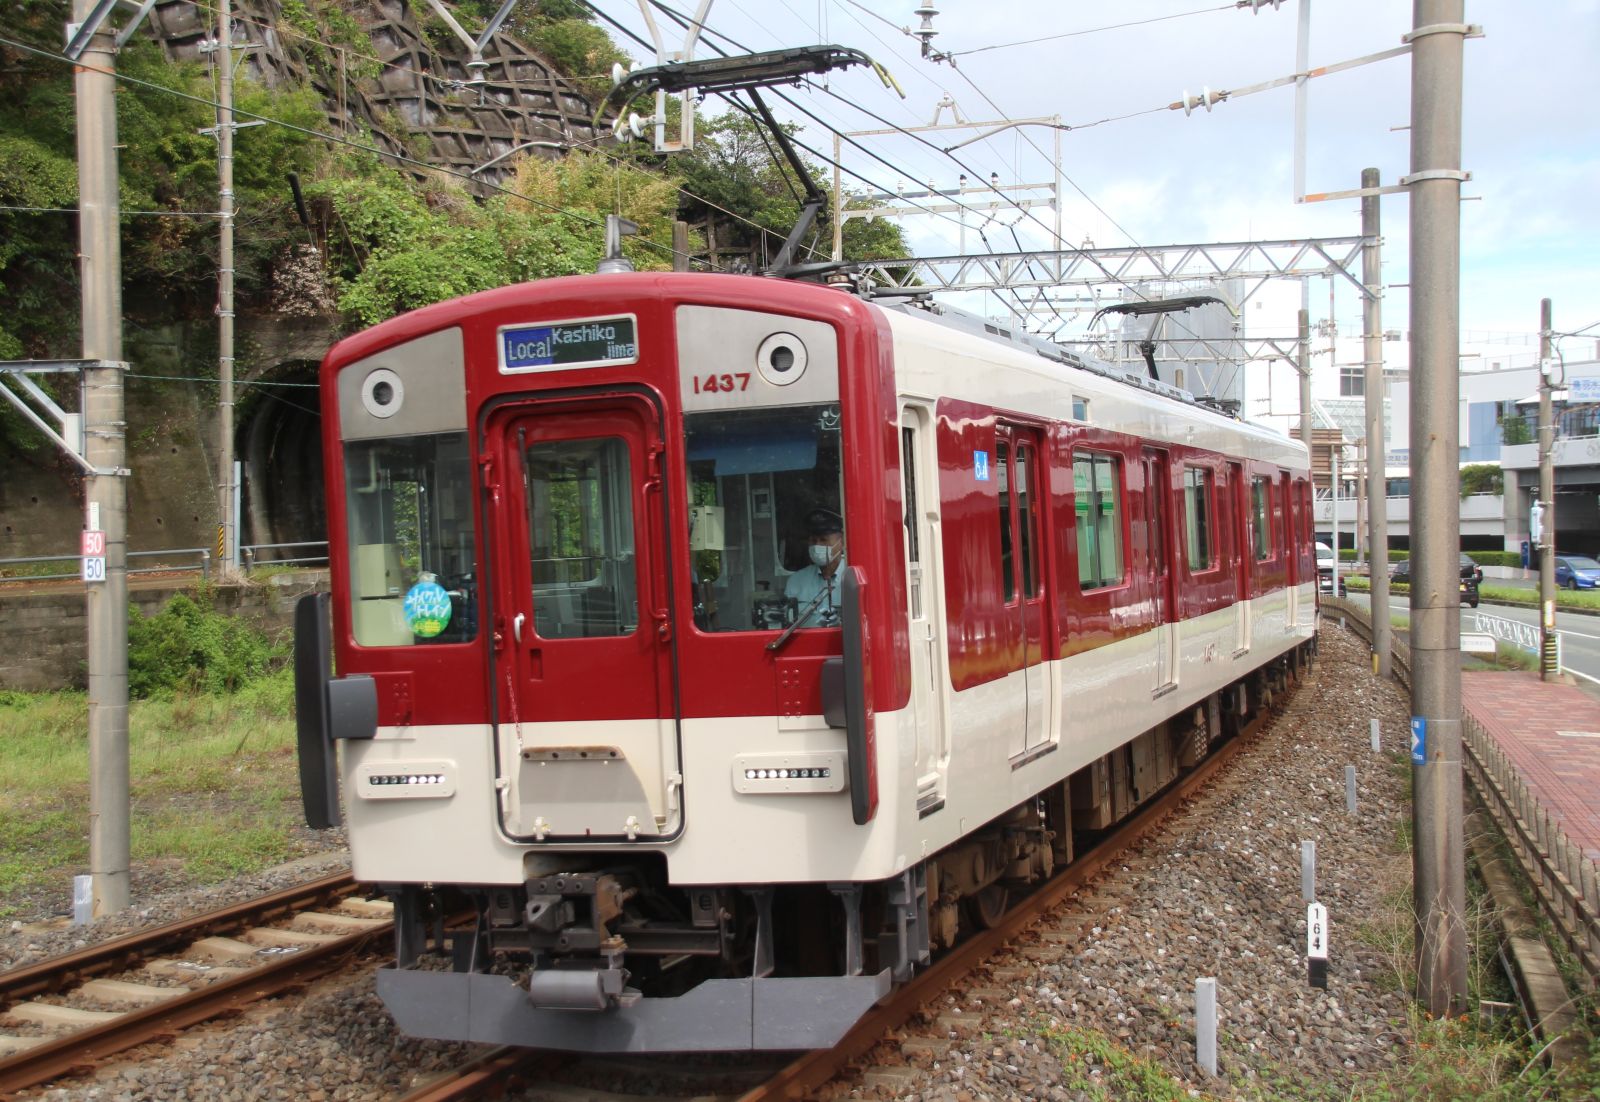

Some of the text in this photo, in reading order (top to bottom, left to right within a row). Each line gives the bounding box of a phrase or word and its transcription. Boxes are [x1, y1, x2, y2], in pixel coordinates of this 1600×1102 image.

[552, 324, 616, 344] Kashiko
[508, 336, 551, 361] Local
[693, 372, 751, 394] 1437
[86, 533, 102, 554] 50
[87, 558, 102, 577] 50
[1313, 907, 1321, 950] 164
